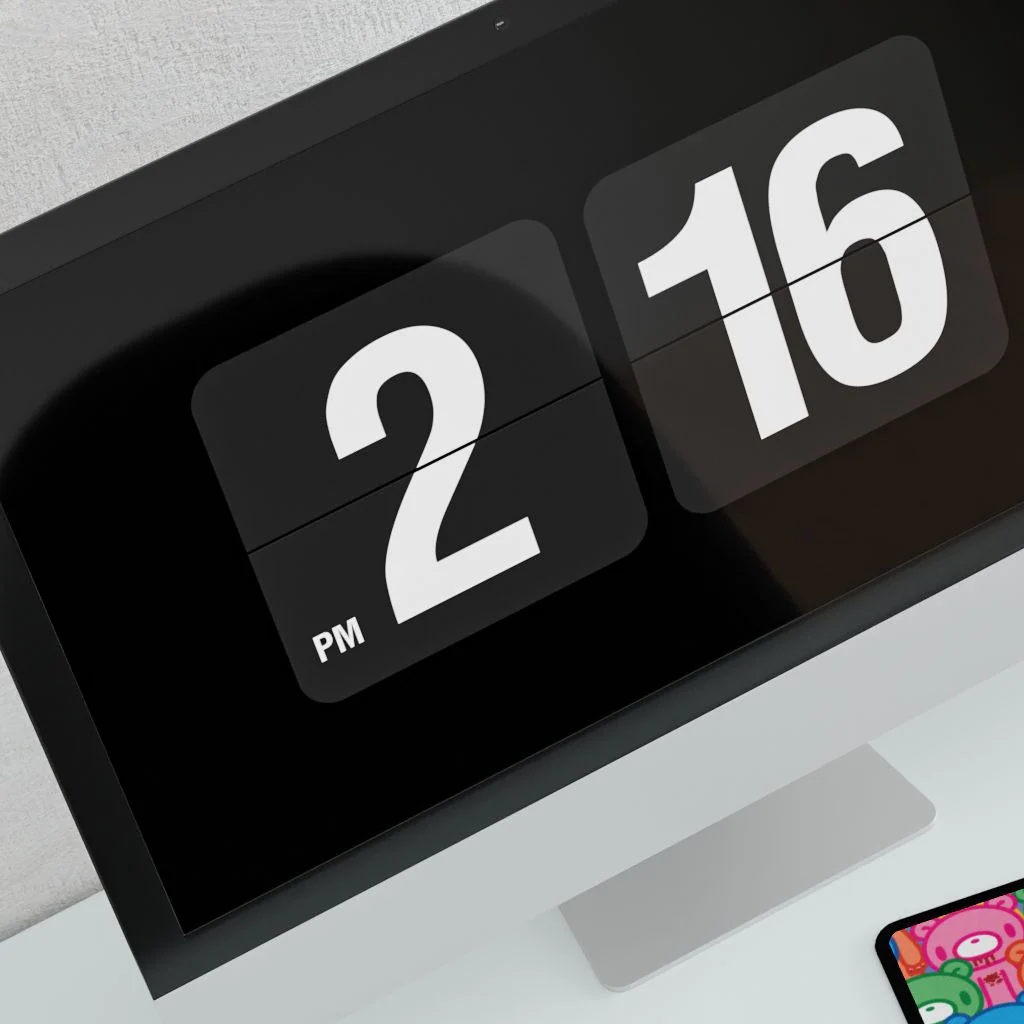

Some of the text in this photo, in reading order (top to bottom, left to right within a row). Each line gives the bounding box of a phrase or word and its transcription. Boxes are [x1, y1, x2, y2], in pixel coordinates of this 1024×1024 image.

[326, 108, 947, 624] 2 16
[312, 616, 365, 664] PM
